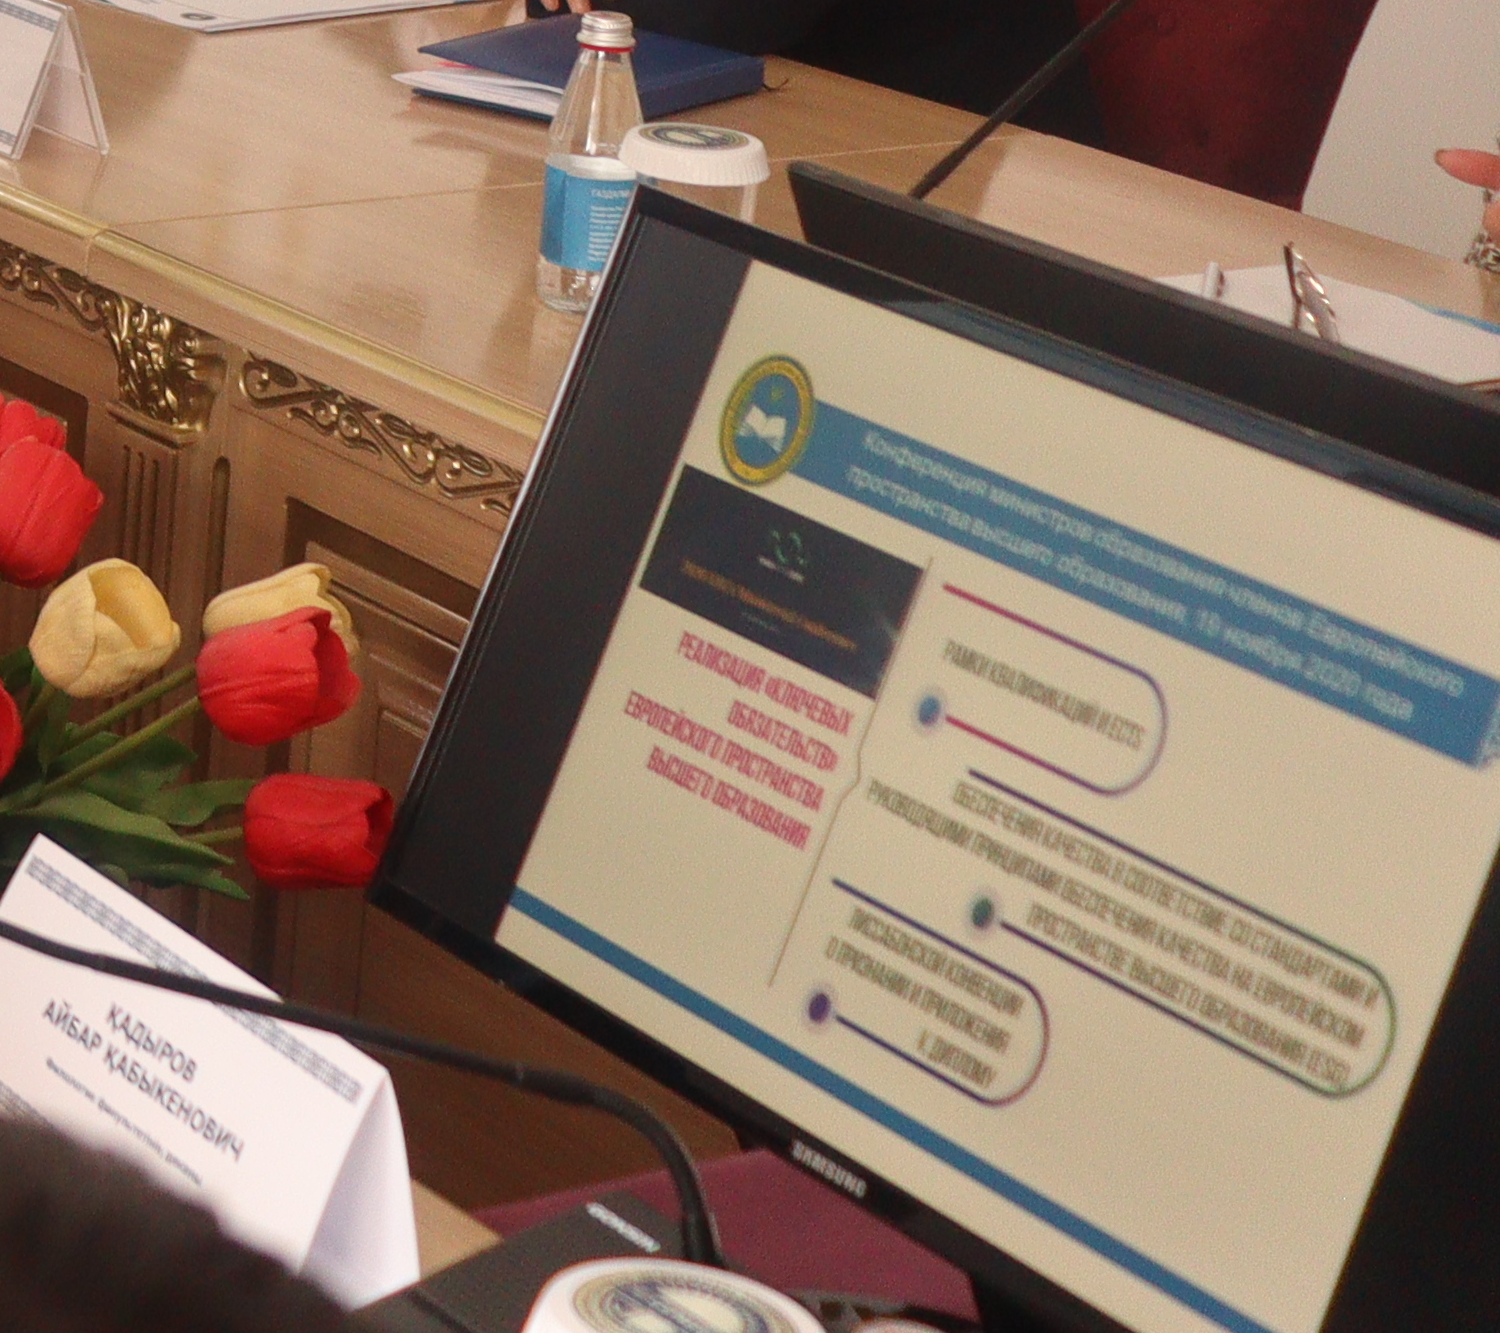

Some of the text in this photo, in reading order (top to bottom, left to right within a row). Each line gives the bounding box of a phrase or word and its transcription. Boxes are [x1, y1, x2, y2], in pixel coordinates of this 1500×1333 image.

[674, 629, 767, 697] РЕАЛИЗАЦИЯ
[622, 683, 827, 814] ЕВРОПЕЙСКОГО ПРОСТРАНСТВА
[644, 743, 813, 852] ВЫСШЕГО ОБРАЗОВАНИЯ
[41, 997, 246, 1163] АЙБАР ҚАБЫКЕНОВИЧ
[105, 1001, 200, 1084] ҚАДЫРОВ
[791, 1139, 868, 1199] SAMSUNG
